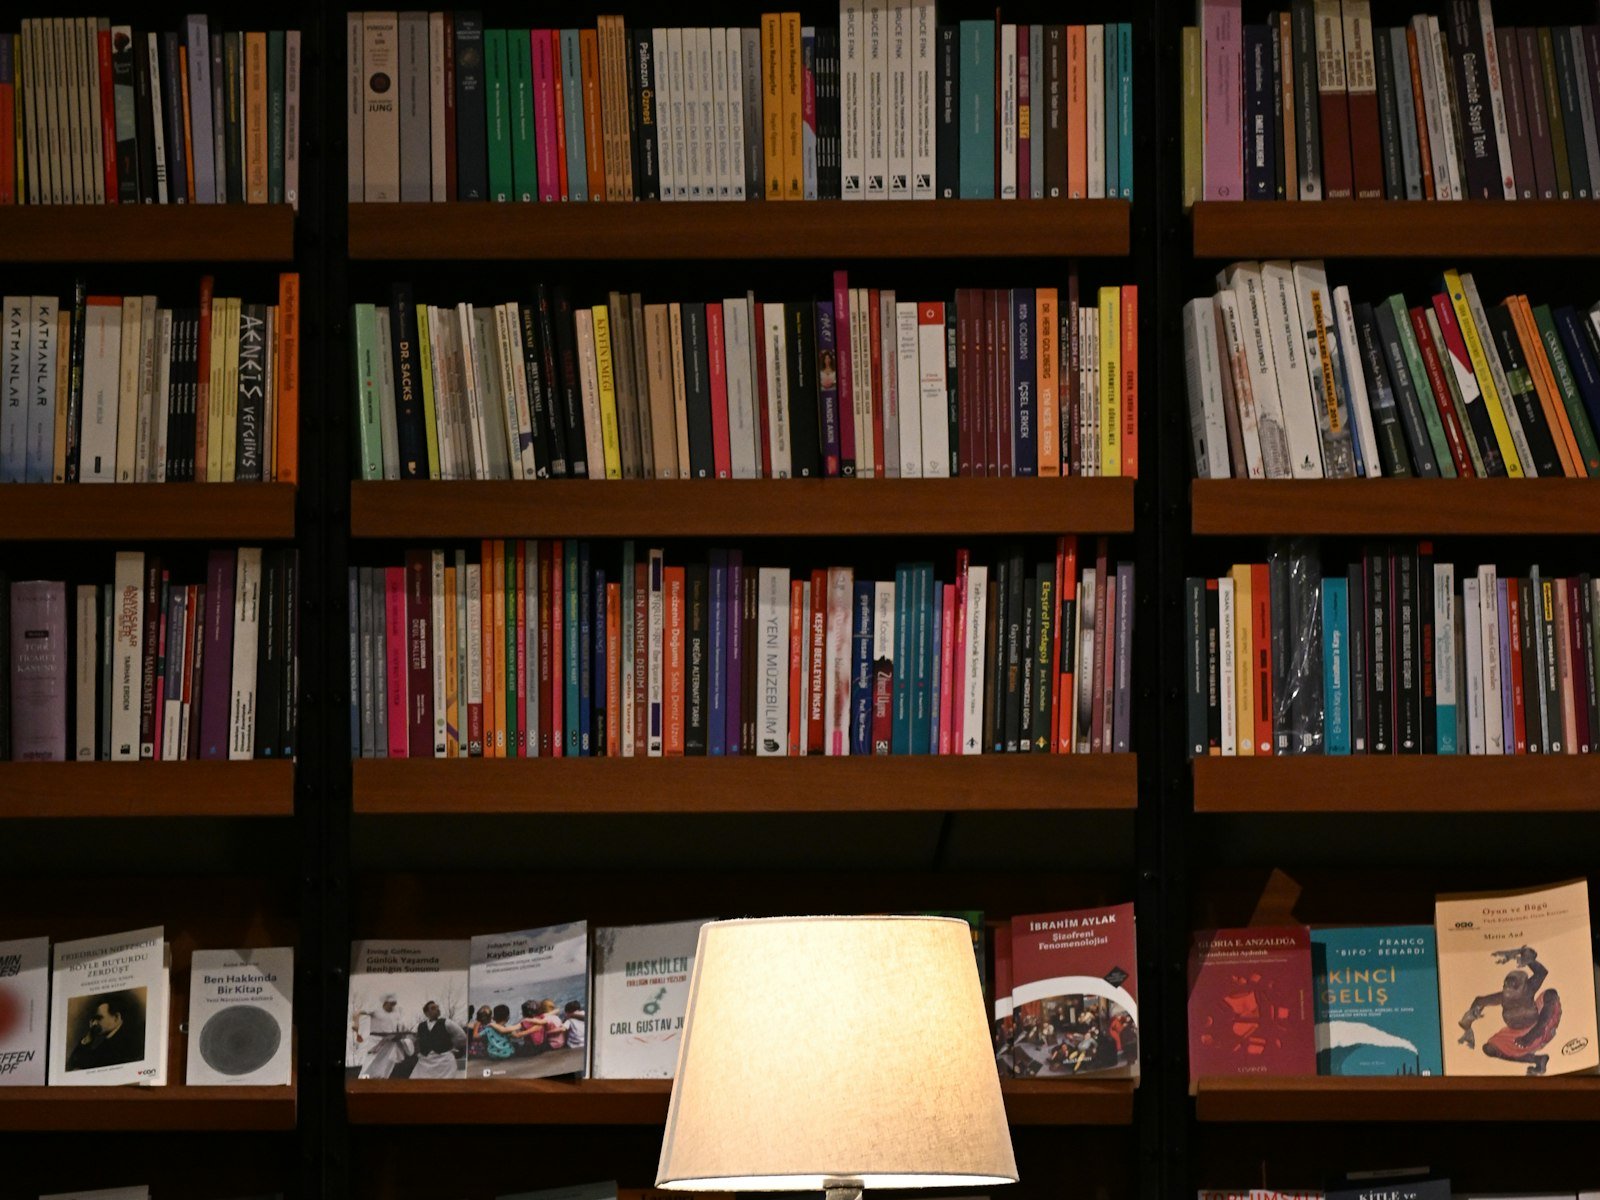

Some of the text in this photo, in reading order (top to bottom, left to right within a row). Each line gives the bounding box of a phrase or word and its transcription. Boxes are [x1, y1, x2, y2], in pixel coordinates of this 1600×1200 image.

[639, 42, 650, 87] Psikozun
[369, 104, 393, 112] JUNG
[1468, 105, 1488, 158] Sosyal Teori
[9, 308, 21, 407] KATMANLAR
[36, 306, 49, 407] KATMANLAR
[400, 341, 413, 401] DR. SACKS
[1020, 410, 1029, 439] ERKEK
[636, 589, 645, 607] BEN
[671, 581, 680, 626] Mucizenin
[130, 586, 138, 647] ANAYASALAR
[1039, 581, 1051, 664] Eleştirel Pedagoji
[636, 612, 645, 653] ANNEME
[637, 658, 646, 689] DEDİM
[766, 617, 778, 734] YENİ MÜZEBİLİM
[812, 612, 824, 720] KEŞFİNİ BEKLEYEN İNSAN
[123, 656, 131, 711] TARHAN ERDEM
[671, 695, 680, 721] Deniz
[671, 723, 680, 748] Uzun
[1482, 907, 1508, 917] Oyun
[1030, 914, 1117, 932] İBRAHİM AYLAK
[1038, 936, 1109, 951] Fenomenolojisi
[1052, 930, 1095, 942] Şizofreni
[1379, 938, 1425, 946] FRANCO
[1484, 931, 1524, 941] Metin And
[61, 948, 107, 962] FRIEDRICH
[101, 954, 149, 968] BUYURDU
[486, 949, 525, 960] Kaybolan
[1378, 948, 1426, 956] BERARDI
[626, 957, 688, 977] MASKÜLEN
[1321, 966, 1397, 984] İKİNCİ
[204, 973, 278, 984] Ben Hakkında
[217, 984, 263, 996] Bir Kitap
[1321, 987, 1389, 1006] GELİŞ
[610, 1018, 685, 1035] CARL GUSTAV JU
[0, 1050, 35, 1064] FFEN
